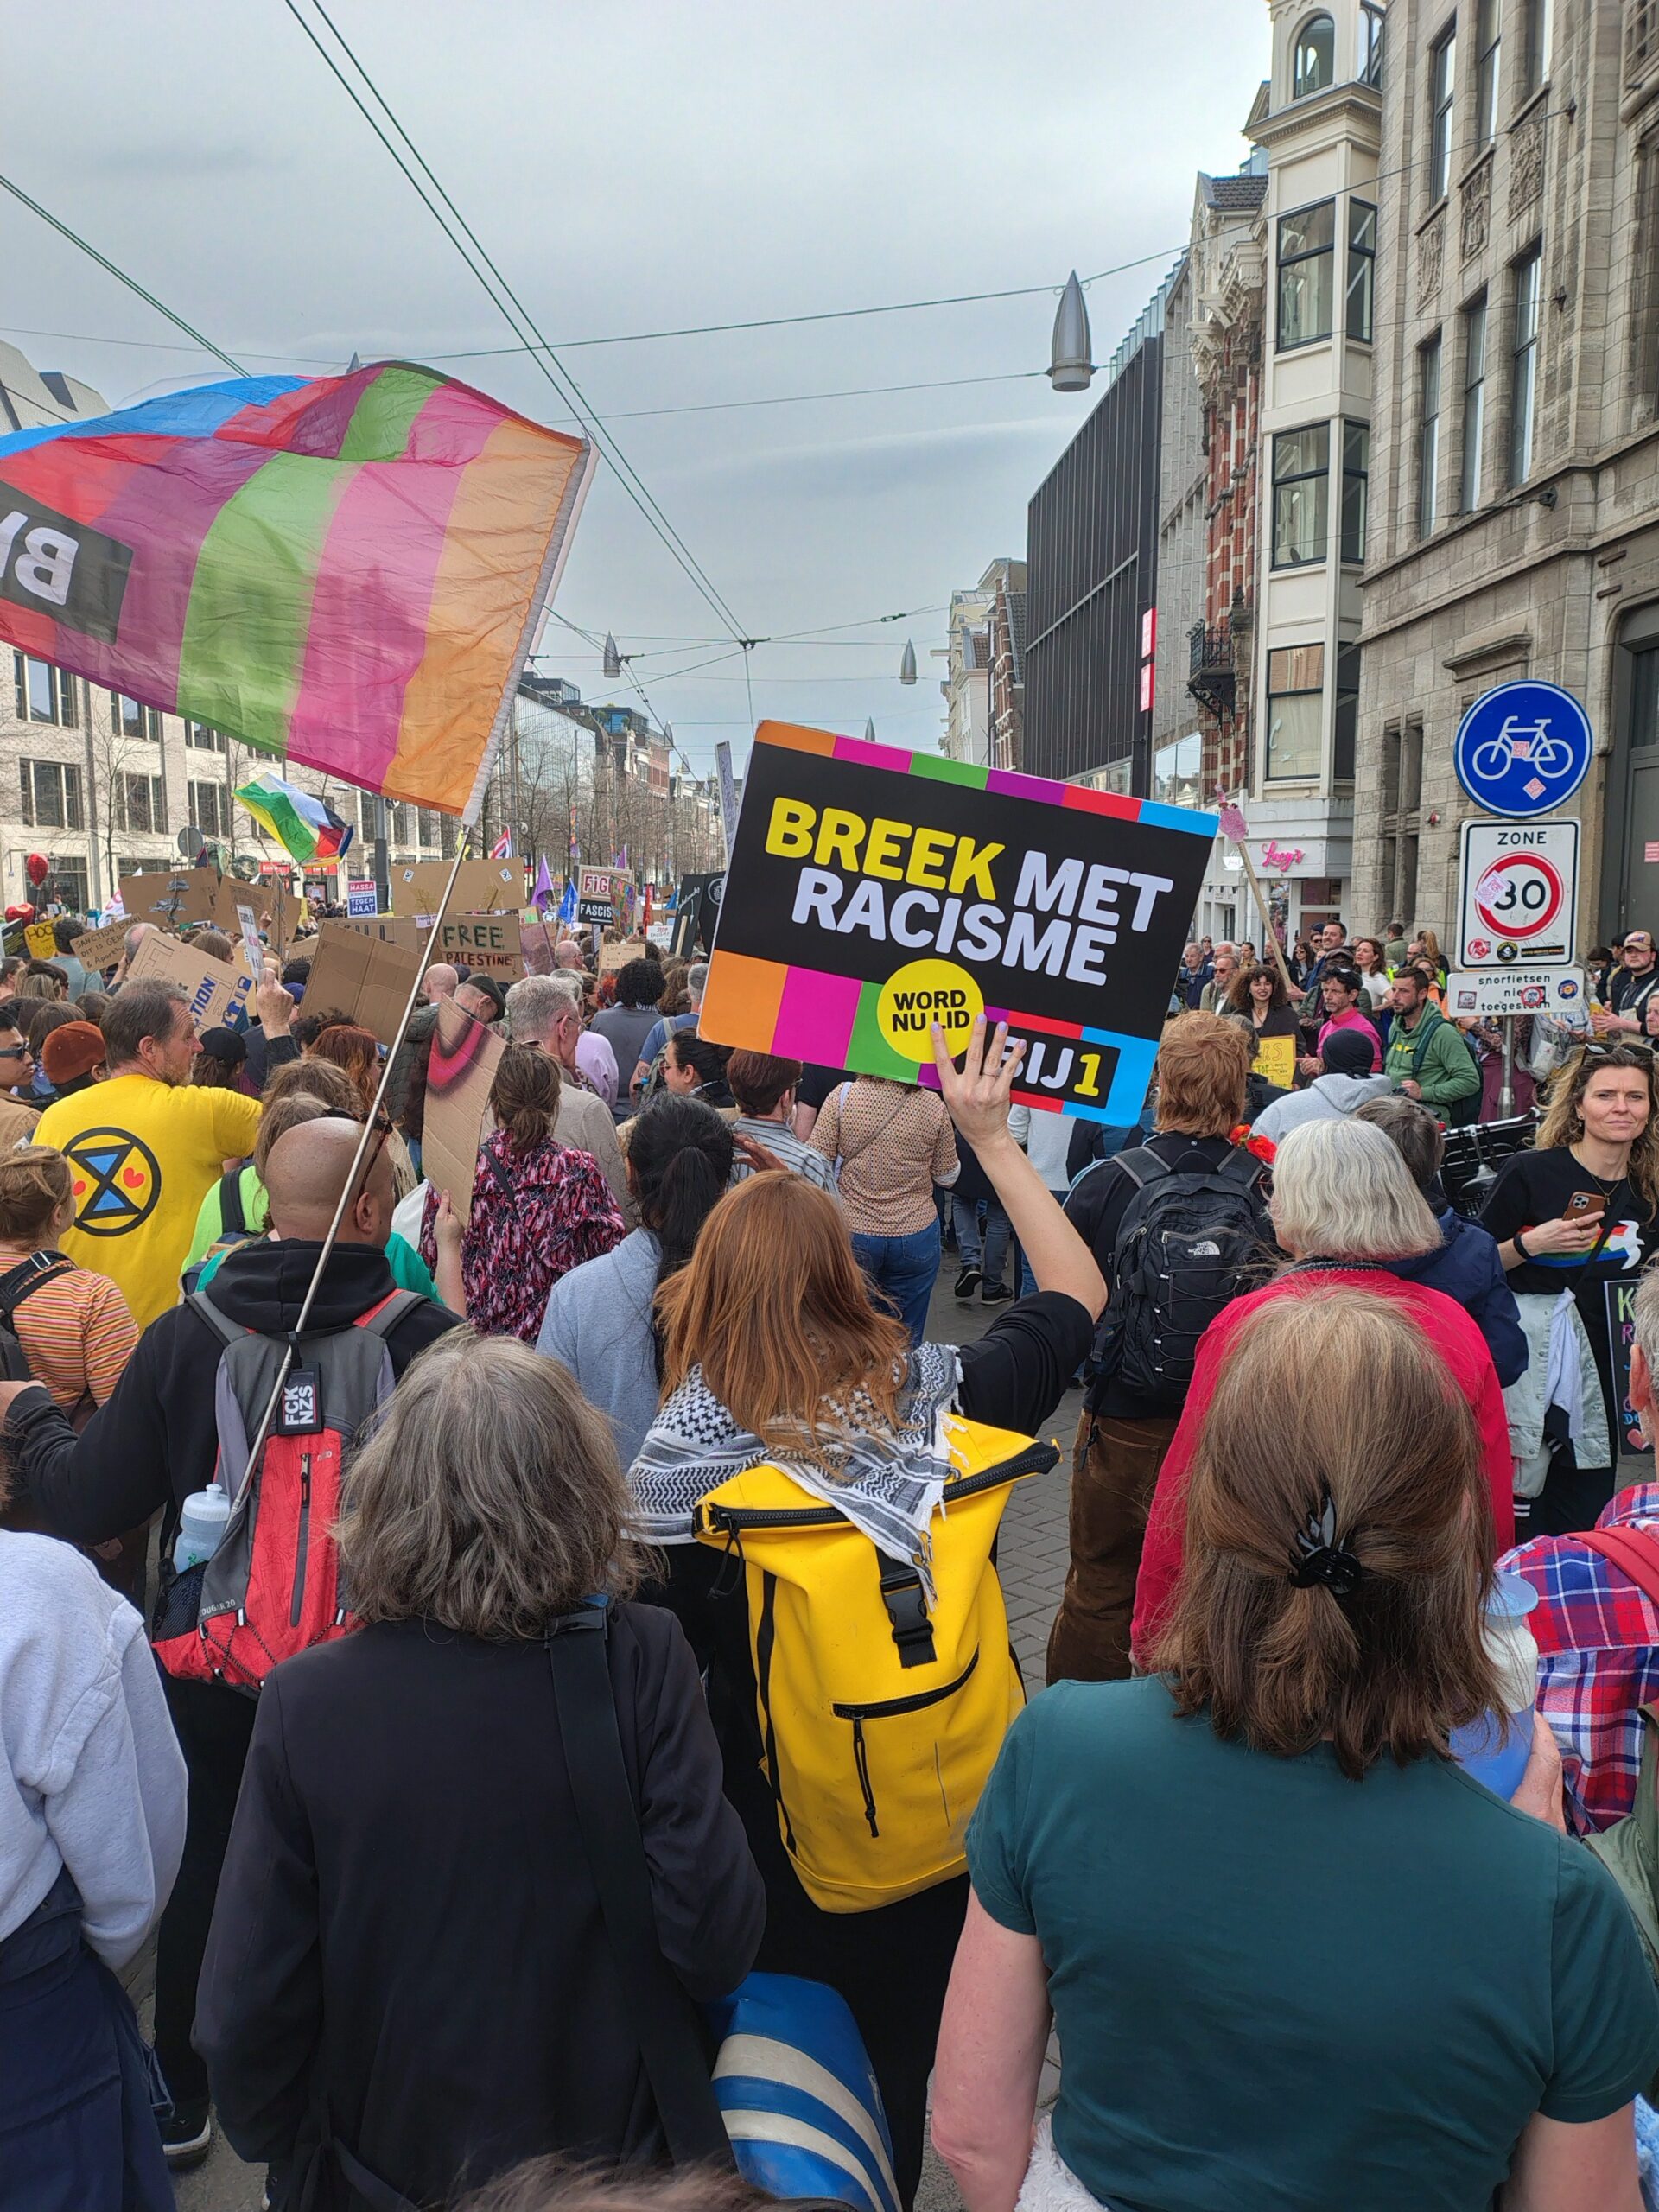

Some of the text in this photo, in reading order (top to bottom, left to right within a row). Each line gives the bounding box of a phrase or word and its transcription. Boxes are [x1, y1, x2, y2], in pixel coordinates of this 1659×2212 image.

[1497, 831, 1548, 846] ZONE
[765, 797, 1005, 901] BREEK
[1014, 850, 1173, 932] MET
[1262, 840, 1306, 872] Lucy's
[351, 897, 374, 906] TEGEN
[1494, 880, 1546, 910] 30
[352, 904, 374, 914] HAAT
[580, 903, 612, 918] FASCiS
[791, 867, 1117, 986] RACISME
[75, 926, 115, 949] SANCTION
[442, 925, 505, 950] FREE
[446, 953, 512, 967] PALESTINE
[1478, 975, 1551, 985] snorfietsen
[893, 990, 966, 1011] WORD
[1503, 988, 1522, 997] nie
[893, 1013, 926, 1032] NU
[284, 1385, 299, 1425] FCK
[299, 1385, 314, 1425] NZS
[226, 1599, 235, 1608] 20
